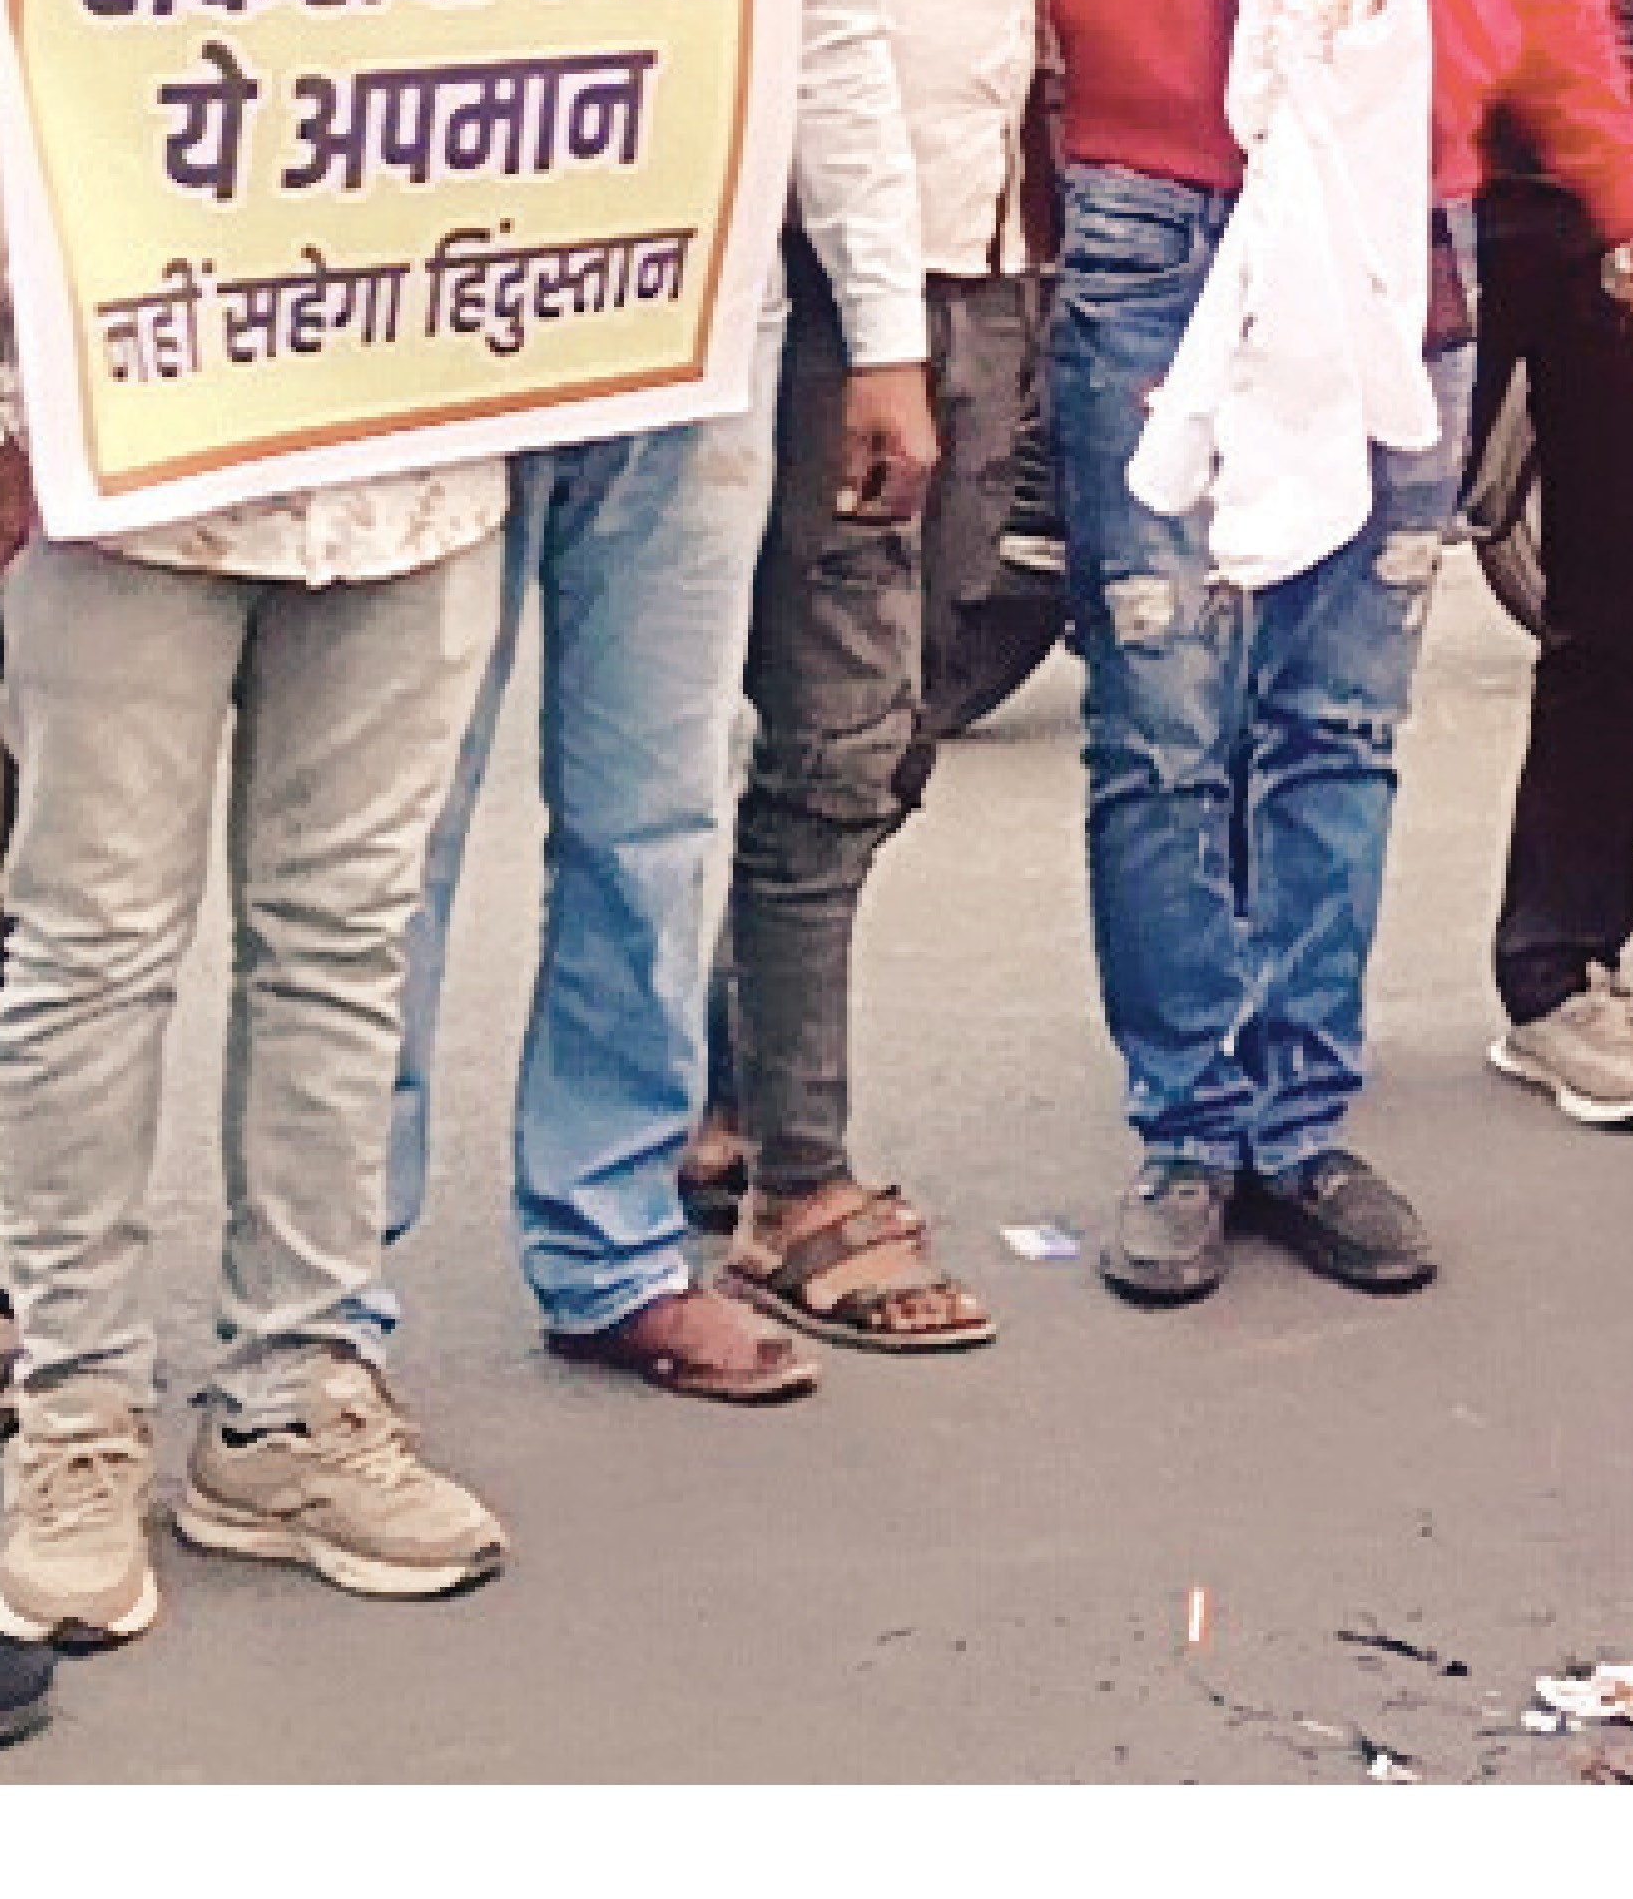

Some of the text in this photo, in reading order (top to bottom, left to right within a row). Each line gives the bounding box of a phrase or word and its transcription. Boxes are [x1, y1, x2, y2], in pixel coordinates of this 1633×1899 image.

[161, 40, 658, 202] ये अपमान
[97, 219, 698, 382] नहीं सहेगा हिंदुस्तान
